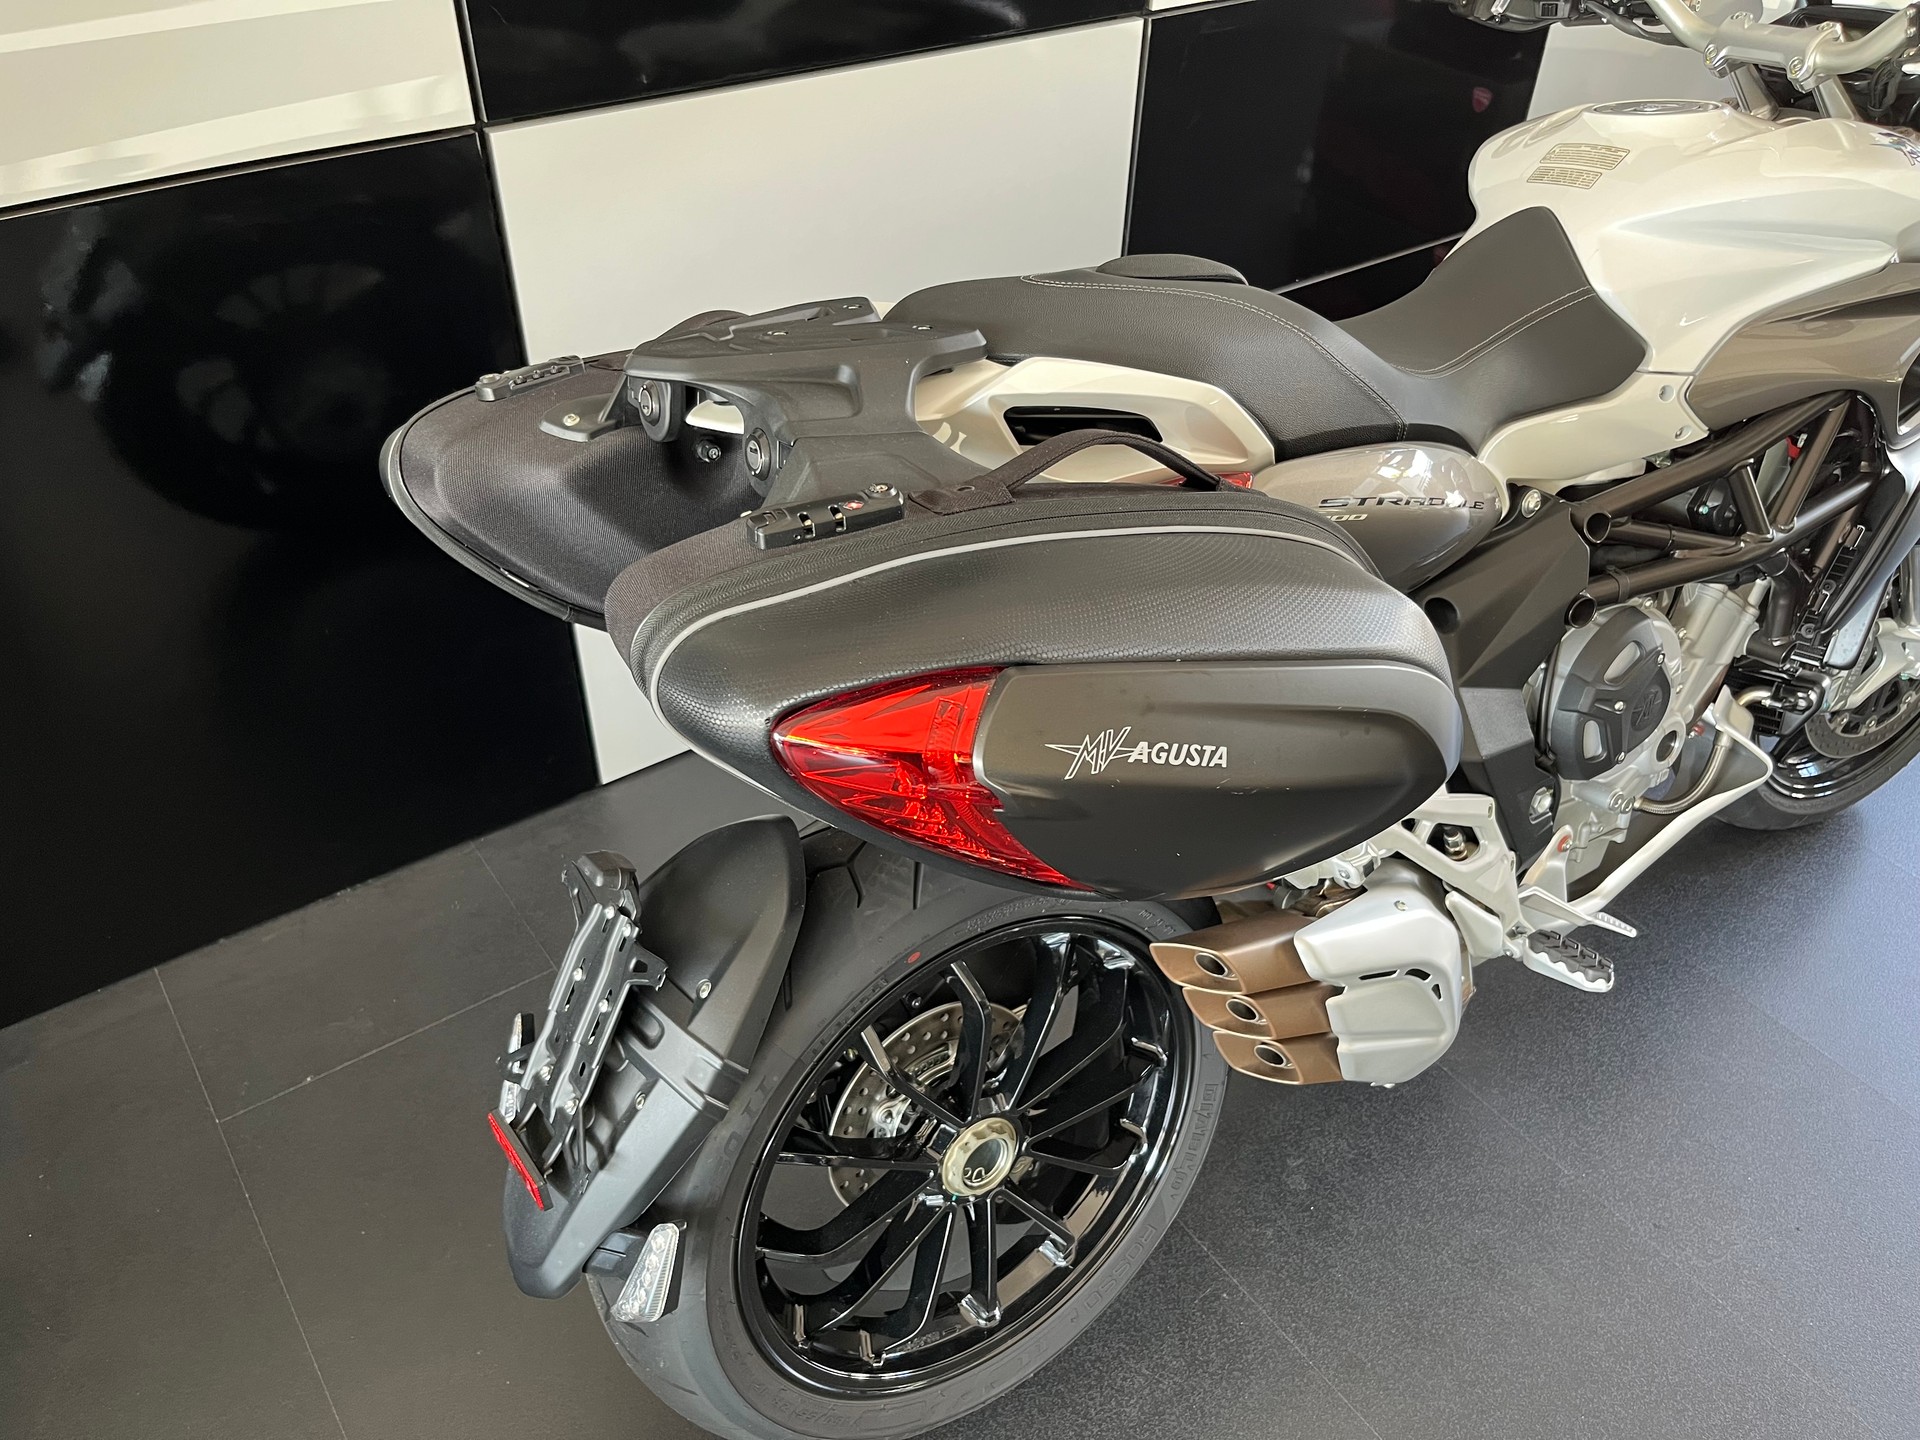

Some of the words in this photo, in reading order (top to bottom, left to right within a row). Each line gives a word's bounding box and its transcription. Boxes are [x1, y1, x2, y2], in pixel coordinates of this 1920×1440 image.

[1318, 496, 1485, 510] STRADLE
[1327, 513, 1369, 522] 00
[1060, 725, 1133, 781] MV
[1127, 741, 1228, 768] AGUSTA
[1084, 1224, 1157, 1310] ROSSO
